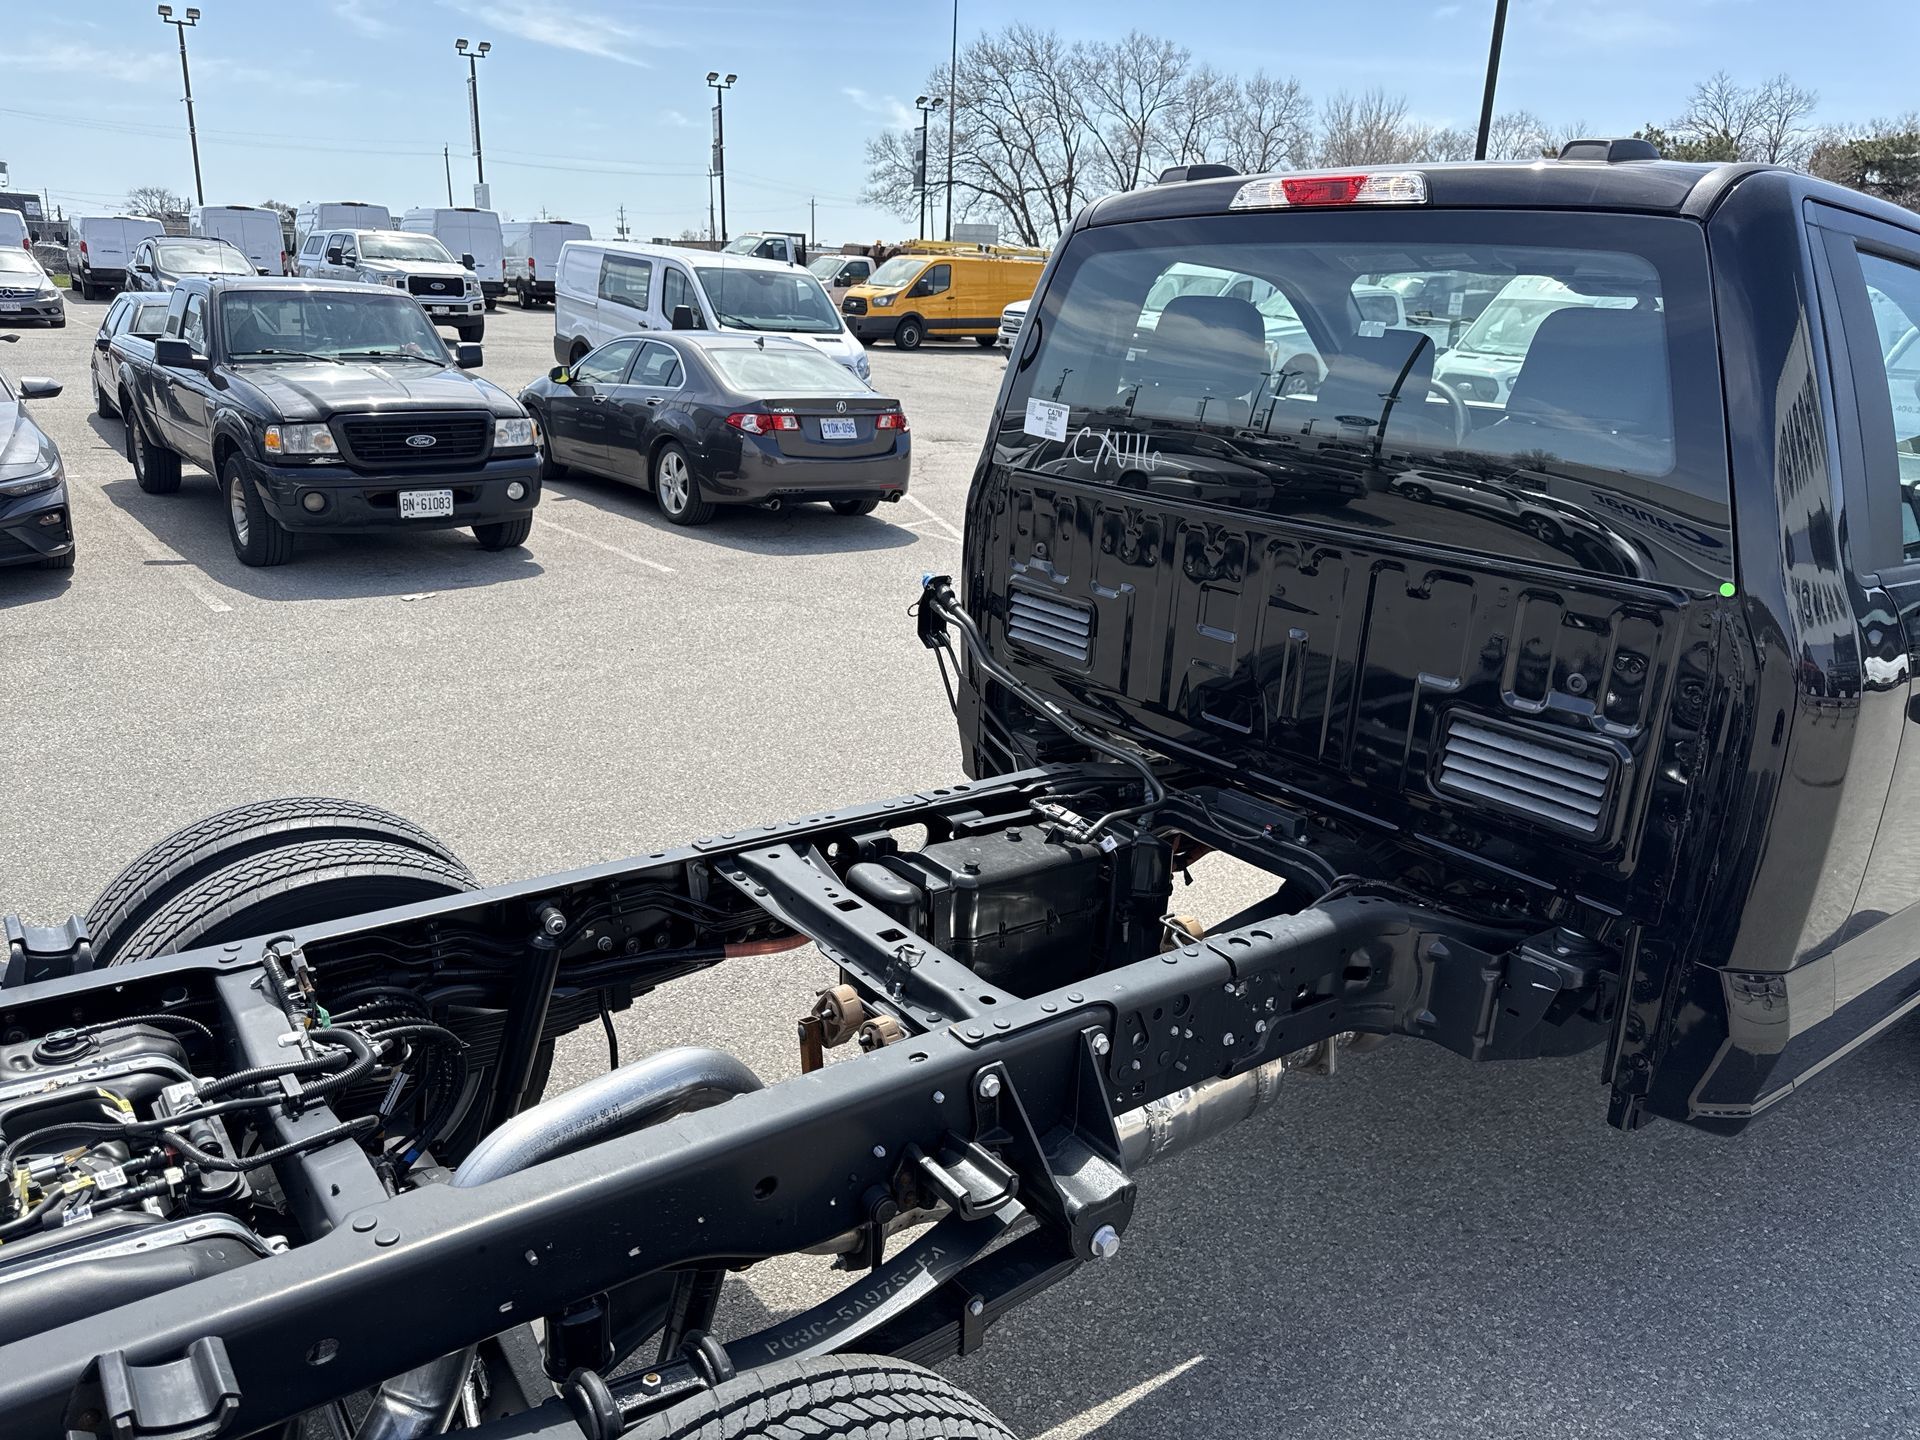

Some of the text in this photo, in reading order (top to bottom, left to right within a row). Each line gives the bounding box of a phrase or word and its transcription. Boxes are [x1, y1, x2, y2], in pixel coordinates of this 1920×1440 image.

[412, 437, 430, 445] Ford
[402, 497, 451, 511] BN 61083
